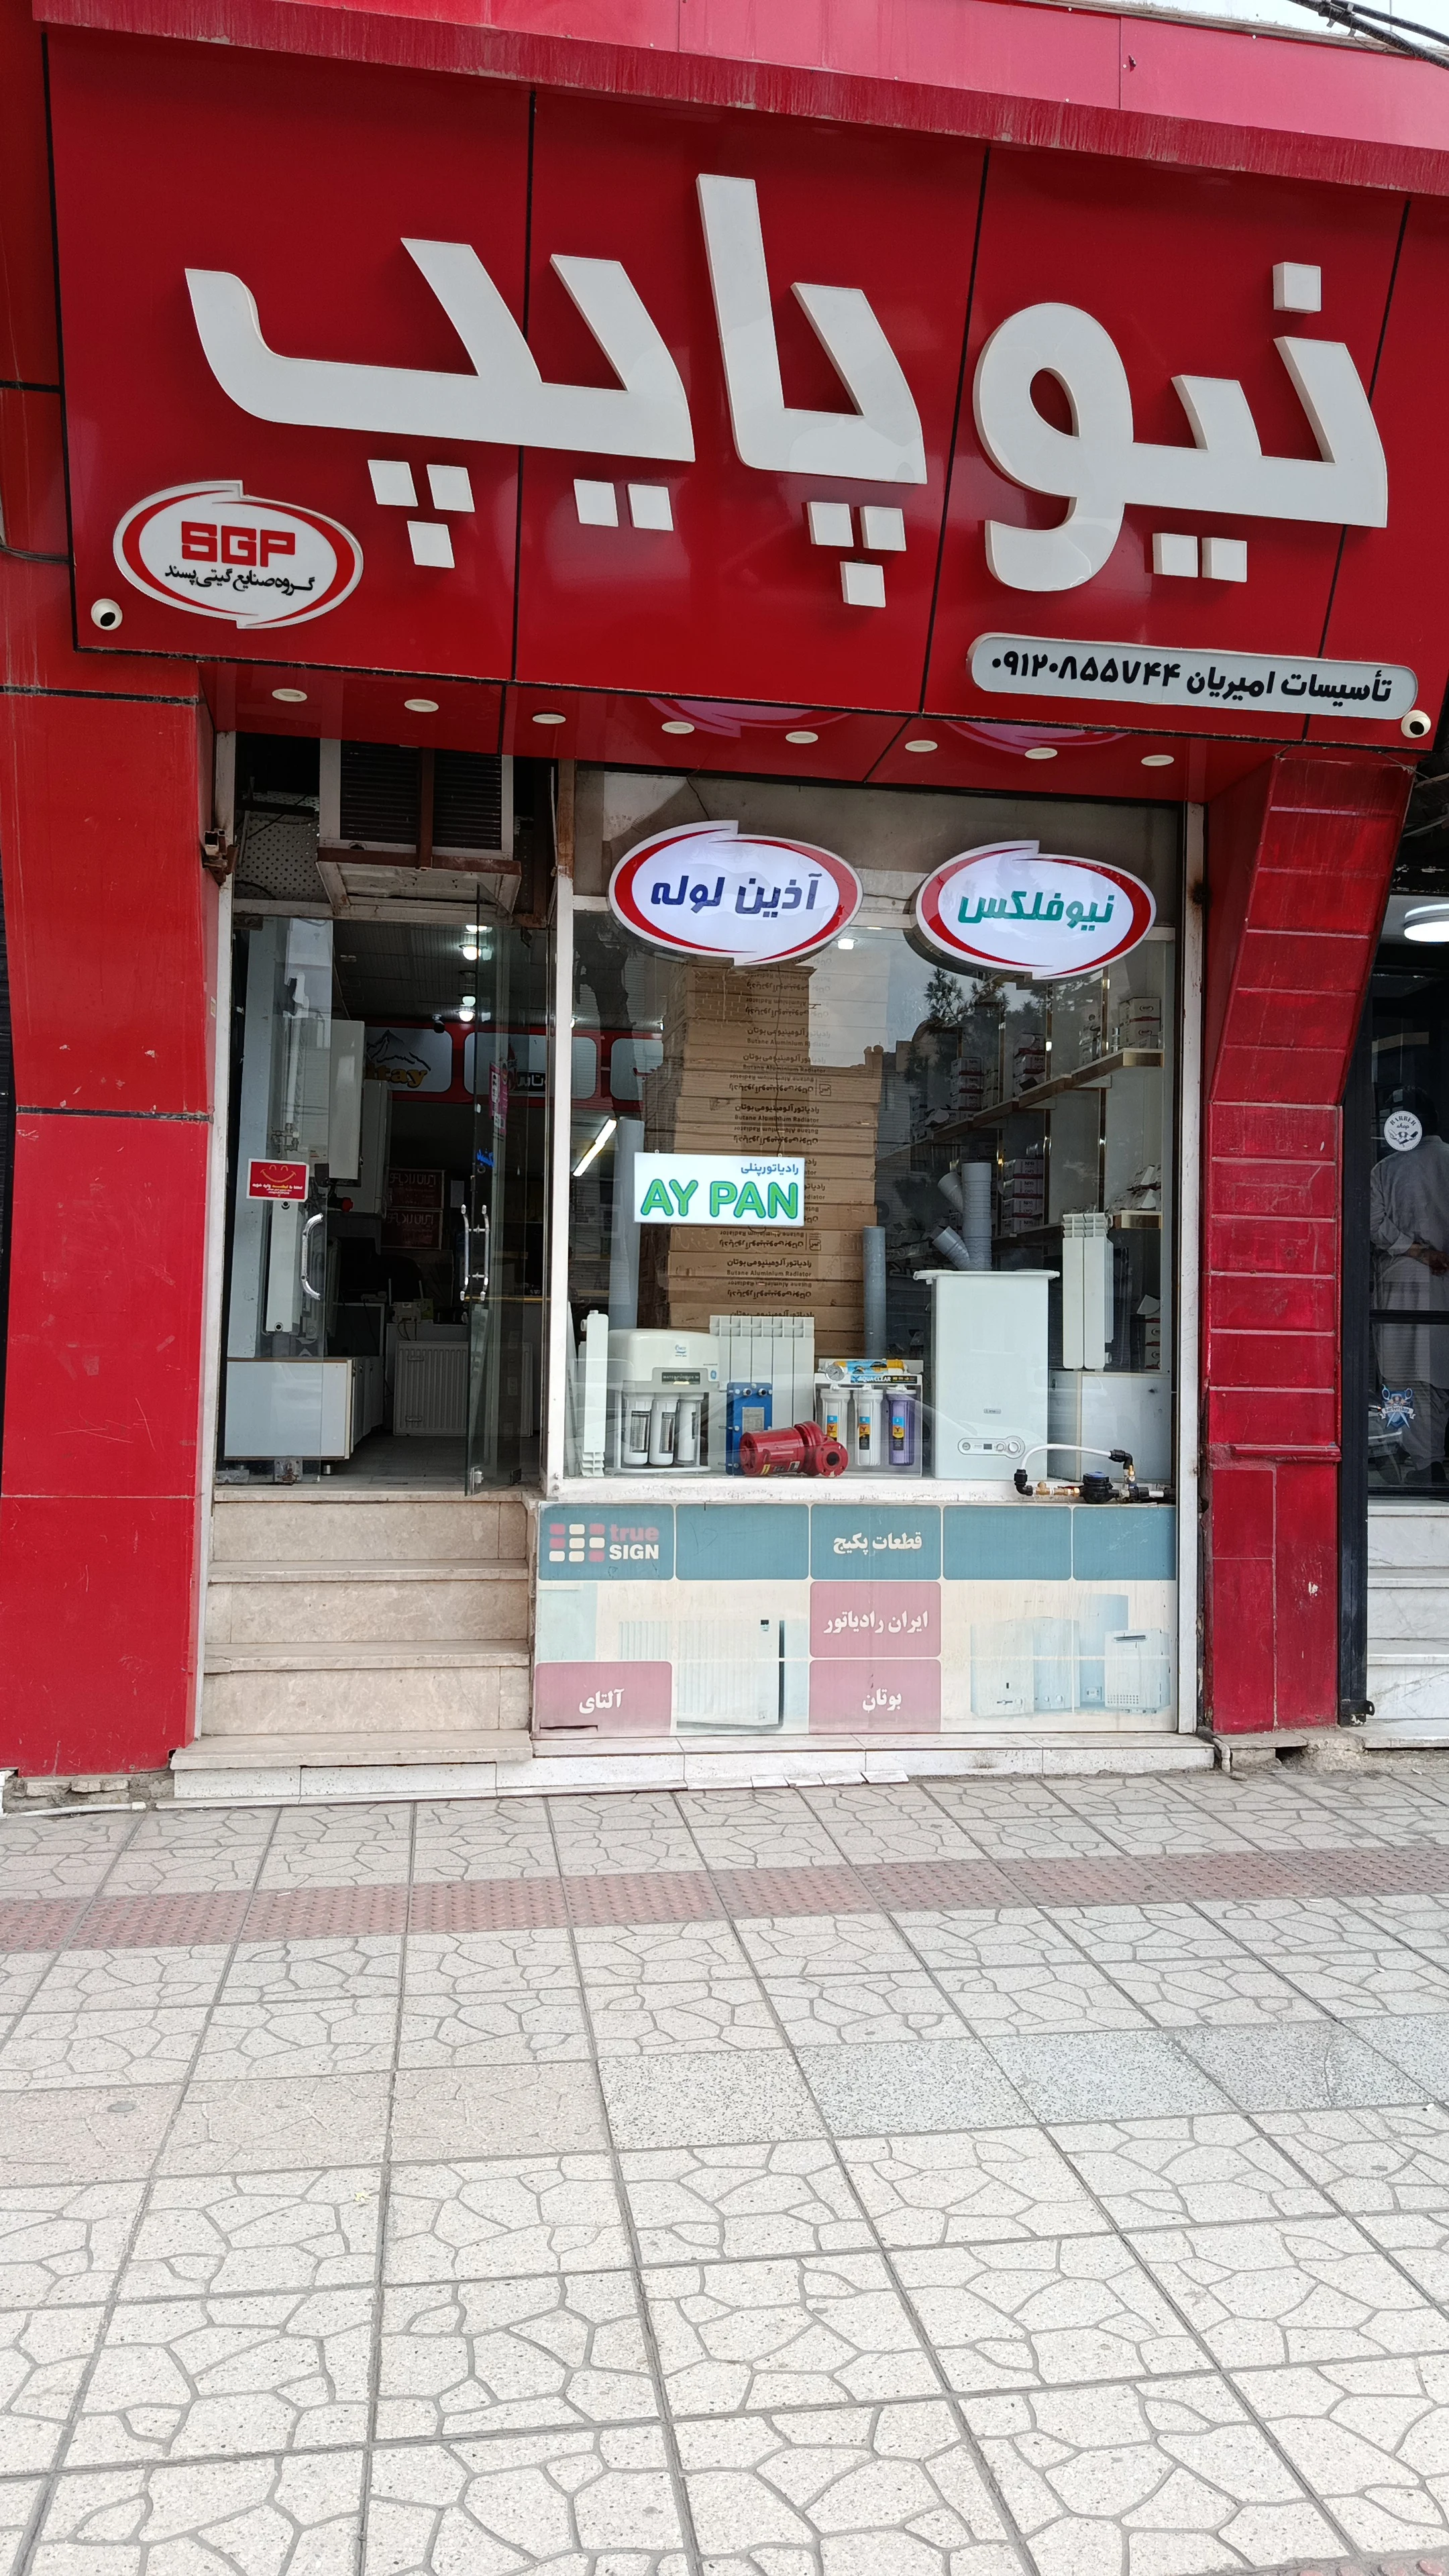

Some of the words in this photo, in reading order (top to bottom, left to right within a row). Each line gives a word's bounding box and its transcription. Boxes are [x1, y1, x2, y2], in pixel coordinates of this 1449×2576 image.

[181, 521, 295, 568] SGP
[233, 570, 275, 592] صنایع
[274, 577, 315, 596] گروه
[991, 651, 1181, 687] ۰۹۱۲۰۸۵۵۷۴۴
[1186, 666, 1276, 701] امیریان
[1281, 669, 1393, 707] تأسیسات
[650, 875, 726, 914] لوله
[735, 873, 822, 918] آذین
[957, 890, 1115, 931] نیوفلکس
[365, 1063, 428, 1088] ltay
[640, 1179, 699, 1217] AY
[709, 1181, 799, 1220] PAN
[805, 1183, 826, 1191] رادیات
[727, 1258, 747, 1267] بوتان
[786, 1259, 812, 1268] رادیاتور
[609, 1523, 659, 1542] true
[833, 1532, 869, 1556] پکیج
[873, 1532, 922, 1552] قطعات
[608, 1544, 659, 1560] SIGN
[823, 1609, 884, 1634] رادیاتور
[888, 1611, 928, 1633] ایران
[579, 1688, 625, 1715] آلتای
[862, 1688, 902, 1713] بوتان
